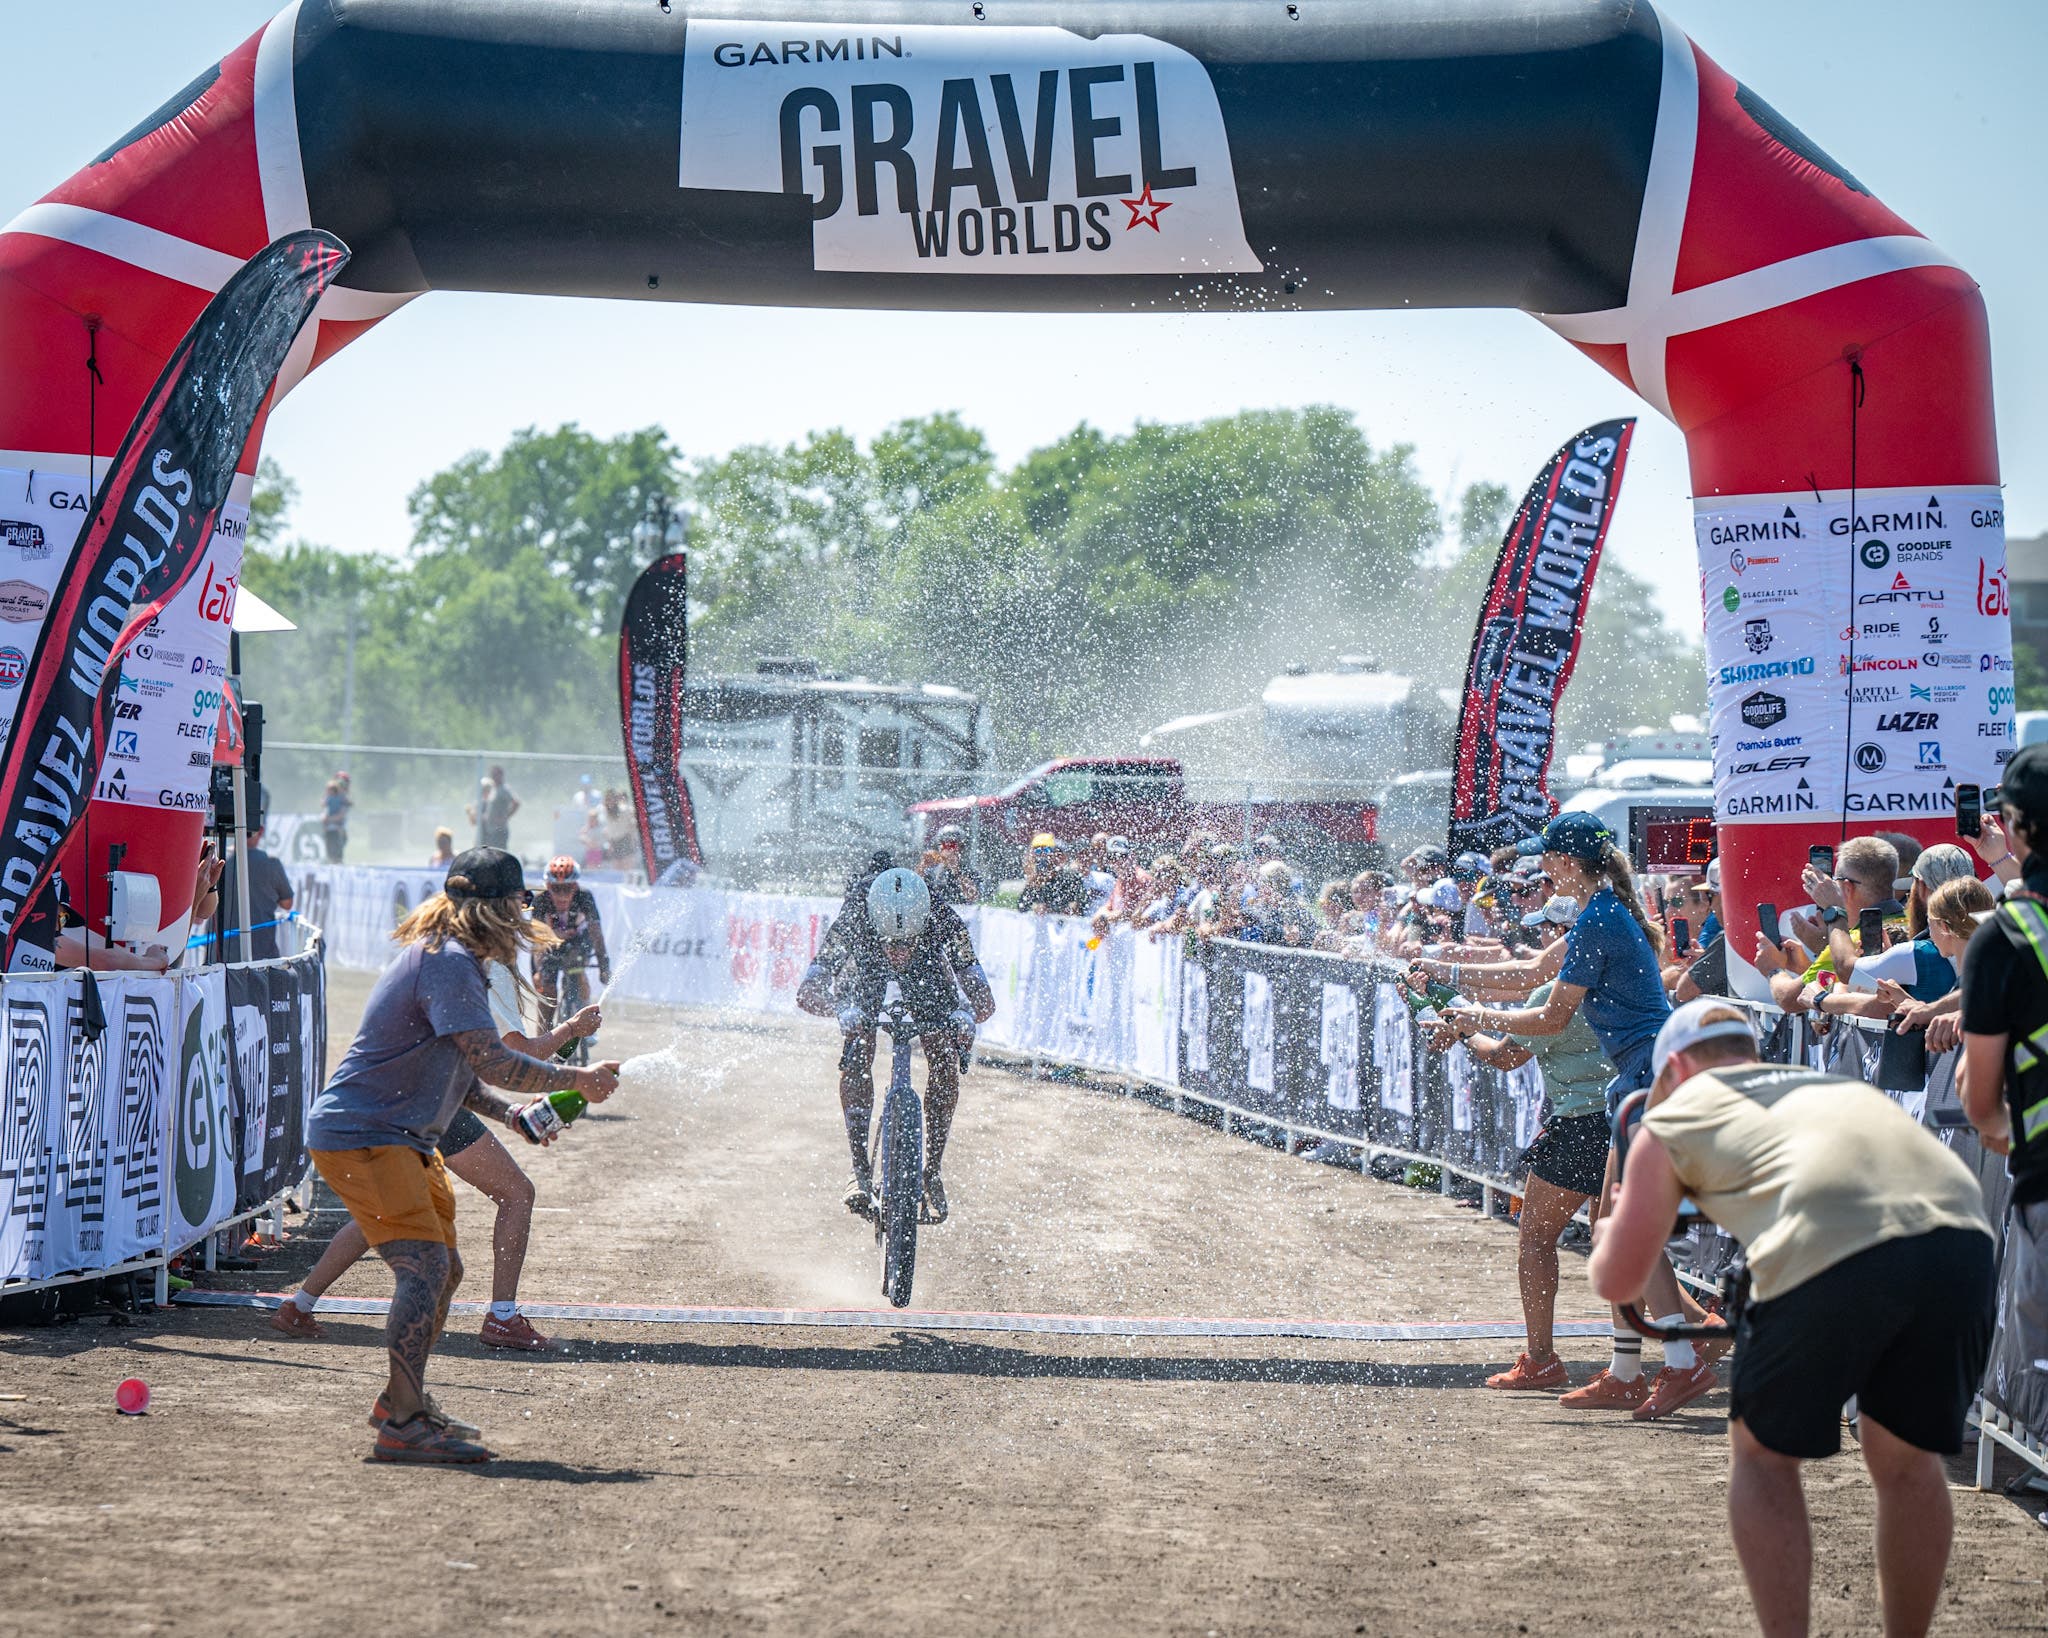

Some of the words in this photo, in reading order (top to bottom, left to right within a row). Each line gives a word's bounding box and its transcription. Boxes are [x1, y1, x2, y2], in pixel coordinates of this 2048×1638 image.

[713, 36, 904, 67] GARMIN
[779, 61, 1197, 220] GRAVEL
[911, 202, 1111, 258] WORLDS
[1829, 510, 1943, 535] GARMIN
[1971, 509, 2004, 528] GAR
[6, 527, 42, 541] GRAVEL
[1524, 434, 1617, 632] WORLDS
[1711, 521, 1801, 545] GARMIN
[1897, 540, 1952, 552] GOODLIFE
[1897, 552, 1944, 563] BRANDS
[70, 449, 194, 699] WORLDS
[1858, 590, 1945, 605] CANTU
[145, 626, 165, 634] COTT
[1863, 622, 1900, 634] RIDE
[1720, 656, 1815, 685] SHIMANO
[1852, 659, 1918, 672] LINCOLN
[141, 678, 174, 688] FALLBROOK
[141, 684, 166, 693] MEDICAL
[140, 690, 163, 698] CENTER
[1845, 686, 1899, 697] CAPITAL
[1852, 695, 1891, 703] DENTAL
[1744, 702, 1783, 717] GOODLIFE
[1876, 711, 1939, 732] LAZER
[177, 722, 207, 739] FLEET
[1978, 722, 2007, 737] FLEET
[1736, 738, 1772, 752] Chamois
[1728, 792, 1814, 816] GARMIN
[271, 1000, 291, 1013] GARMIN
[272, 1042, 290, 1055] GARMIN
